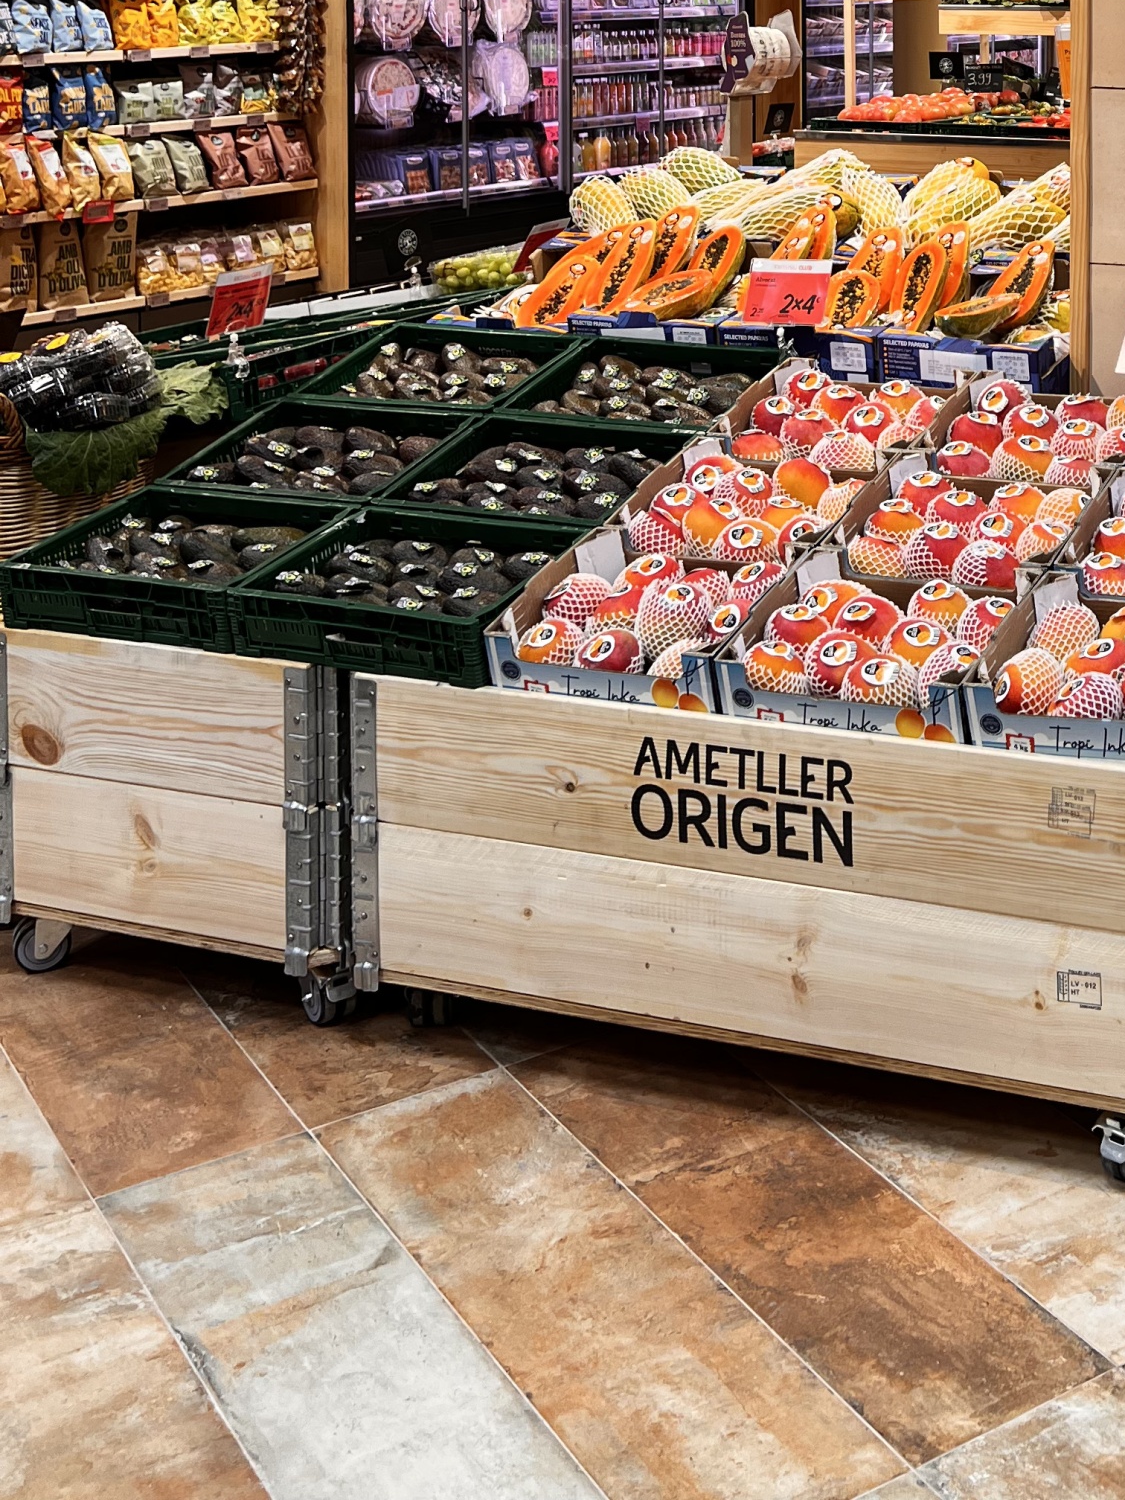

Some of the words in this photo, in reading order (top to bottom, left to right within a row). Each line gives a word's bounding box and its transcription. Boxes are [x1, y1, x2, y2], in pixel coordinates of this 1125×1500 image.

[730, 40, 746, 48] 100%
[883, 339, 907, 347] SELECTED
[561, 675, 600, 699] Tropi
[607, 679, 640, 703] Inka
[797, 702, 839, 728] Tropi
[847, 708, 883, 733] Inka
[1049, 725, 1094, 759] Tropi
[634, 736, 855, 805] AMETLLER
[631, 783, 854, 867] ORIGEN
[1070, 989, 1080, 997] HT
